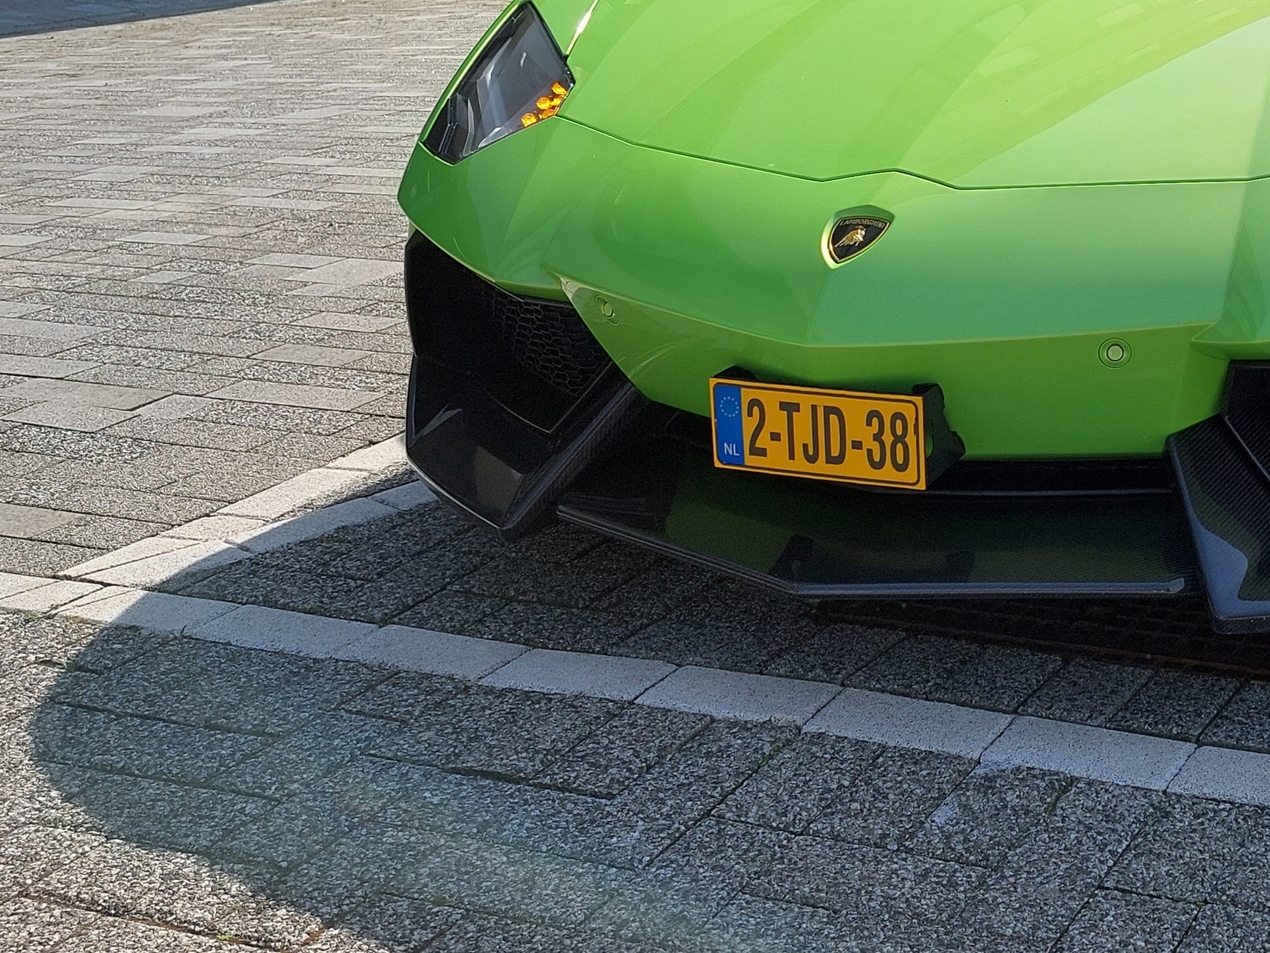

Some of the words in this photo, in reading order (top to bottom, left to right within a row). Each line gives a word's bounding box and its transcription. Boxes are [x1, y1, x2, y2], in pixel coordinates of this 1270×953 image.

[839, 218, 886, 229] LAMBORGHINI
[746, 397, 910, 473] 2-TJD-38
[723, 442, 740, 457] NL
